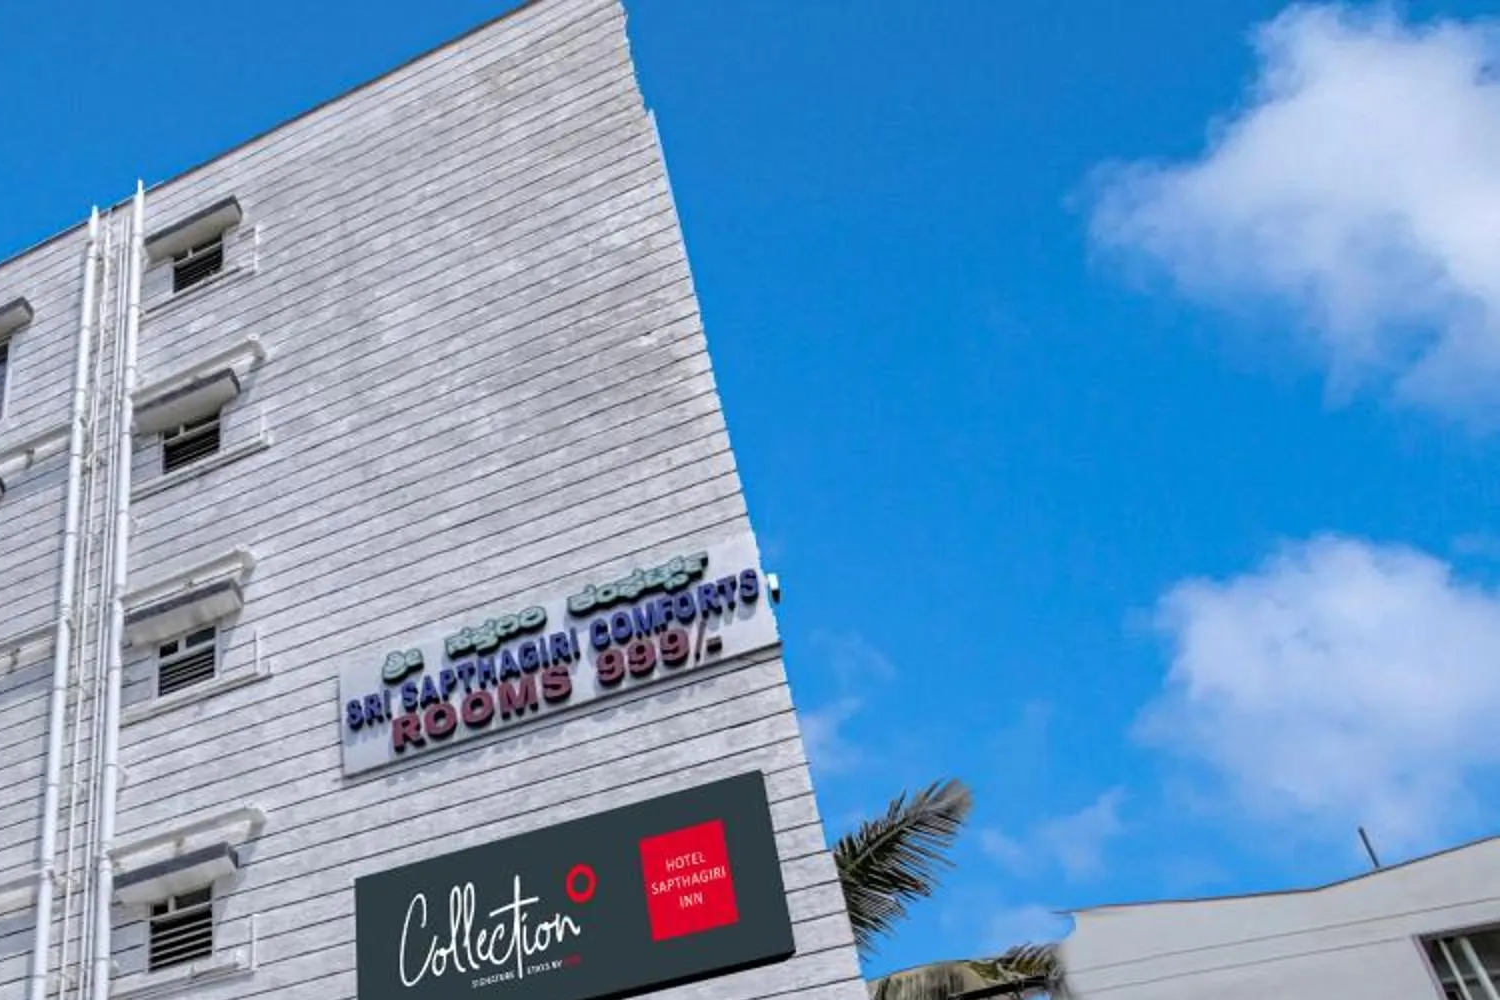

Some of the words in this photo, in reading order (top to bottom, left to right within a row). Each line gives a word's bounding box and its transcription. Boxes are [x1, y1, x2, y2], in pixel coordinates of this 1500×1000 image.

[346, 697, 391, 730] SRI
[401, 633, 580, 712] SAPTHAGIRI
[590, 568, 760, 650] COMFORTS
[381, 648, 423, 682] ಶ್ರೀ
[391, 665, 573, 754] ROOMS
[595, 617, 722, 687] 999/-
[665, 852, 706, 872] HOTEL
[651, 866, 727, 895] SAPTHAGIRI
[679, 892, 703, 909] INN
[399, 875, 581, 987] Collection
